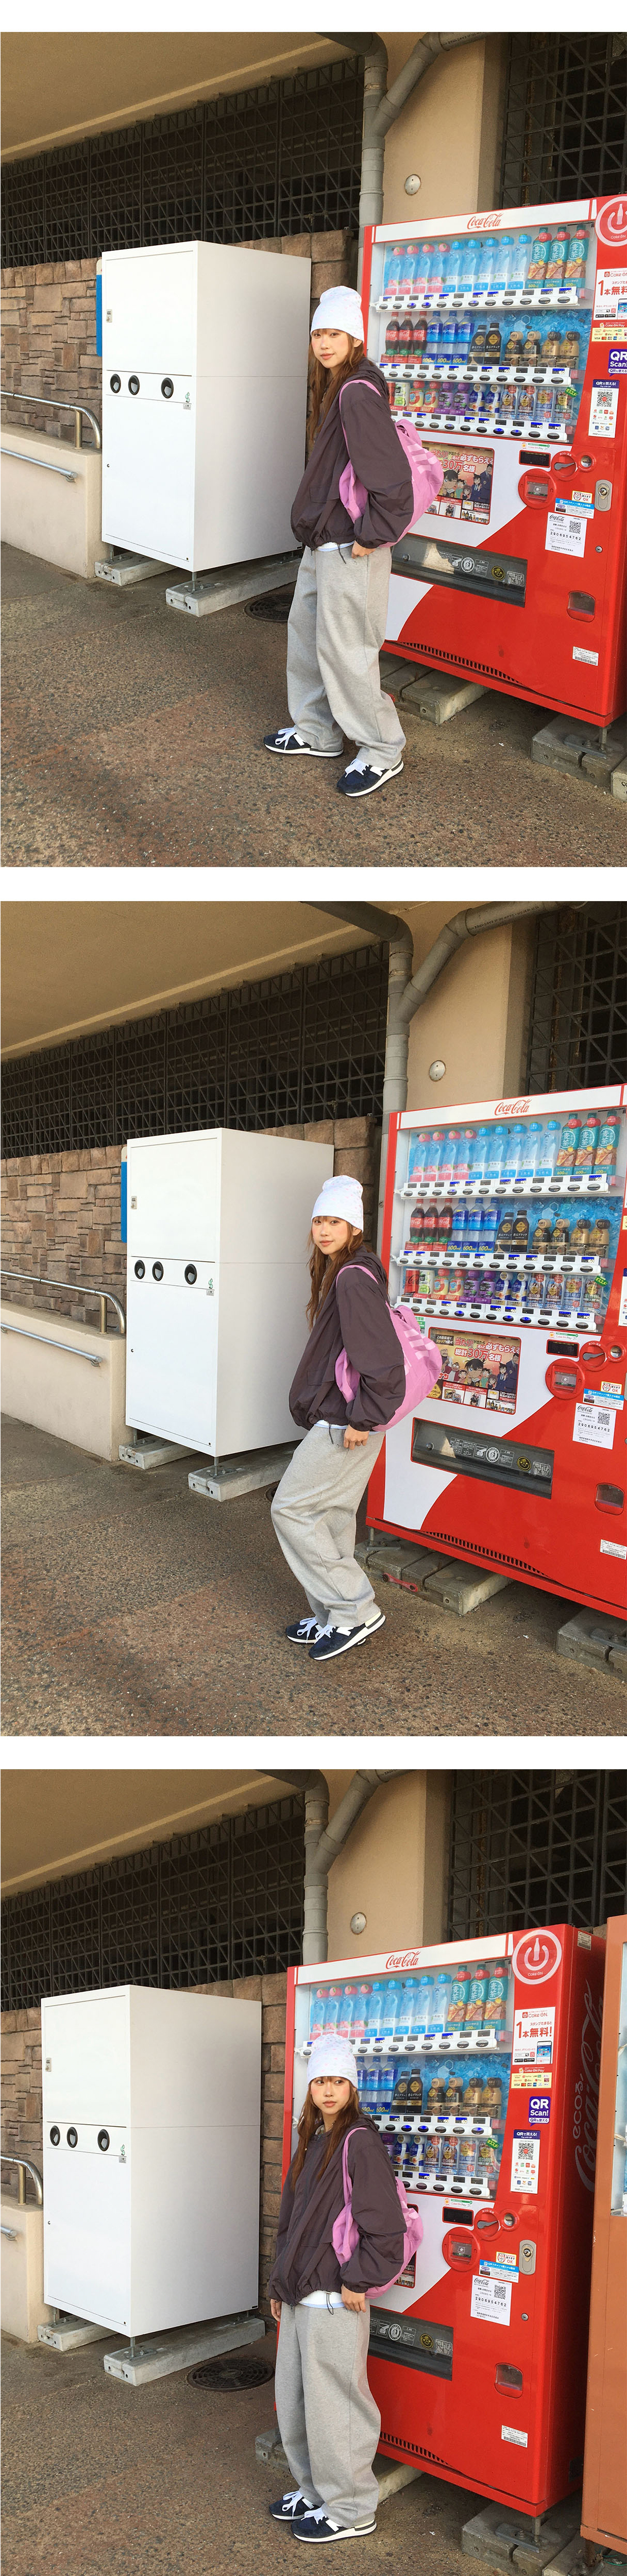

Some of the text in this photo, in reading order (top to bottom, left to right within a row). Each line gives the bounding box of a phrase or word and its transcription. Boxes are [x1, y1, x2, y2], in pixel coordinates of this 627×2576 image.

[467, 213, 503, 229] Coca-Cola
[534, 246, 541, 260] 麦茶
[552, 245, 559, 259] 麦茶
[571, 244, 579, 258] 麦茶
[550, 531, 581, 540] 2906954762
[494, 1099, 532, 1116] Coca-Cola
[563, 1132, 570, 1146] 麦茶
[581, 1131, 589, 1146] 麦茶
[601, 1130, 609, 1144] 麦茶
[454, 1337, 474, 1347] 当たり!
[578, 1422, 610, 1432] 2906954762
[385, 1951, 421, 1969] Coca-Cola
[452, 1984, 460, 2001] 麦茶
[471, 1984, 478, 1998] 麦茶
[490, 1982, 497, 1997] 麦茶
[516, 2021, 552, 2038] 1本無料!
[530, 2098, 549, 2109] QR
[474, 2277, 489, 2286] Coca-Cola
[475, 2296, 506, 2307] 2906954762
